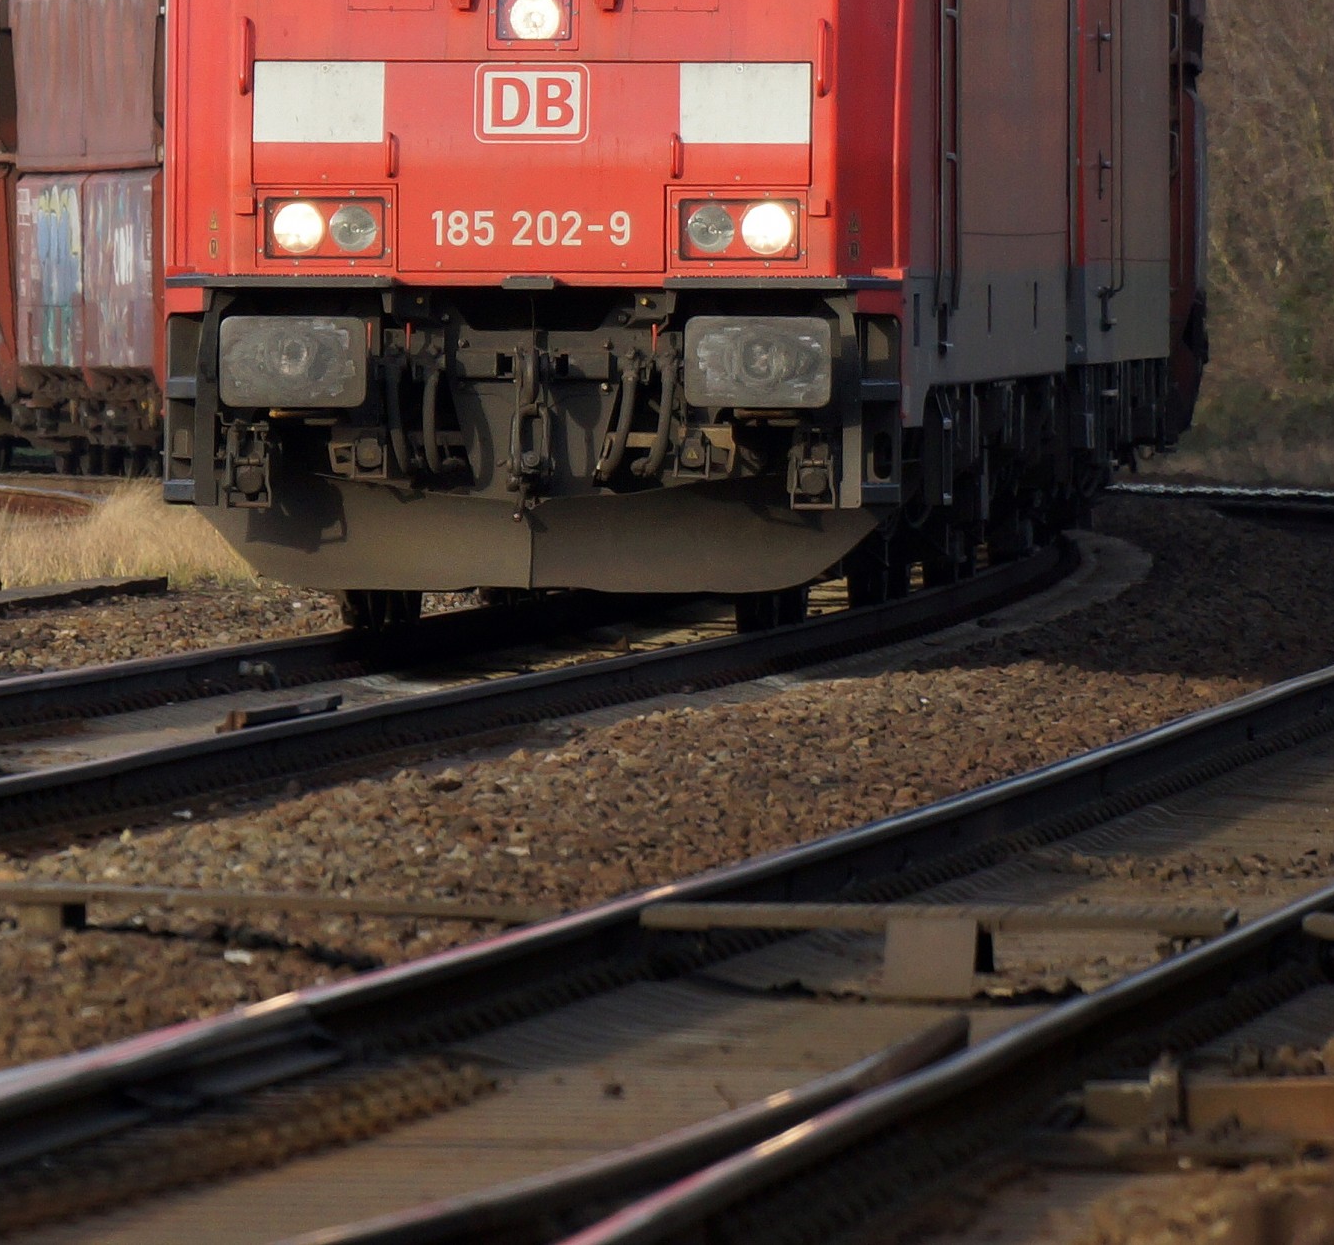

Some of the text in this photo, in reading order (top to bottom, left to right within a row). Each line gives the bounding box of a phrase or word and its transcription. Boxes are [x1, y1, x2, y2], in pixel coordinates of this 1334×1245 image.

[490, 76, 575, 129] DB
[430, 209, 632, 247] 185 202-9
